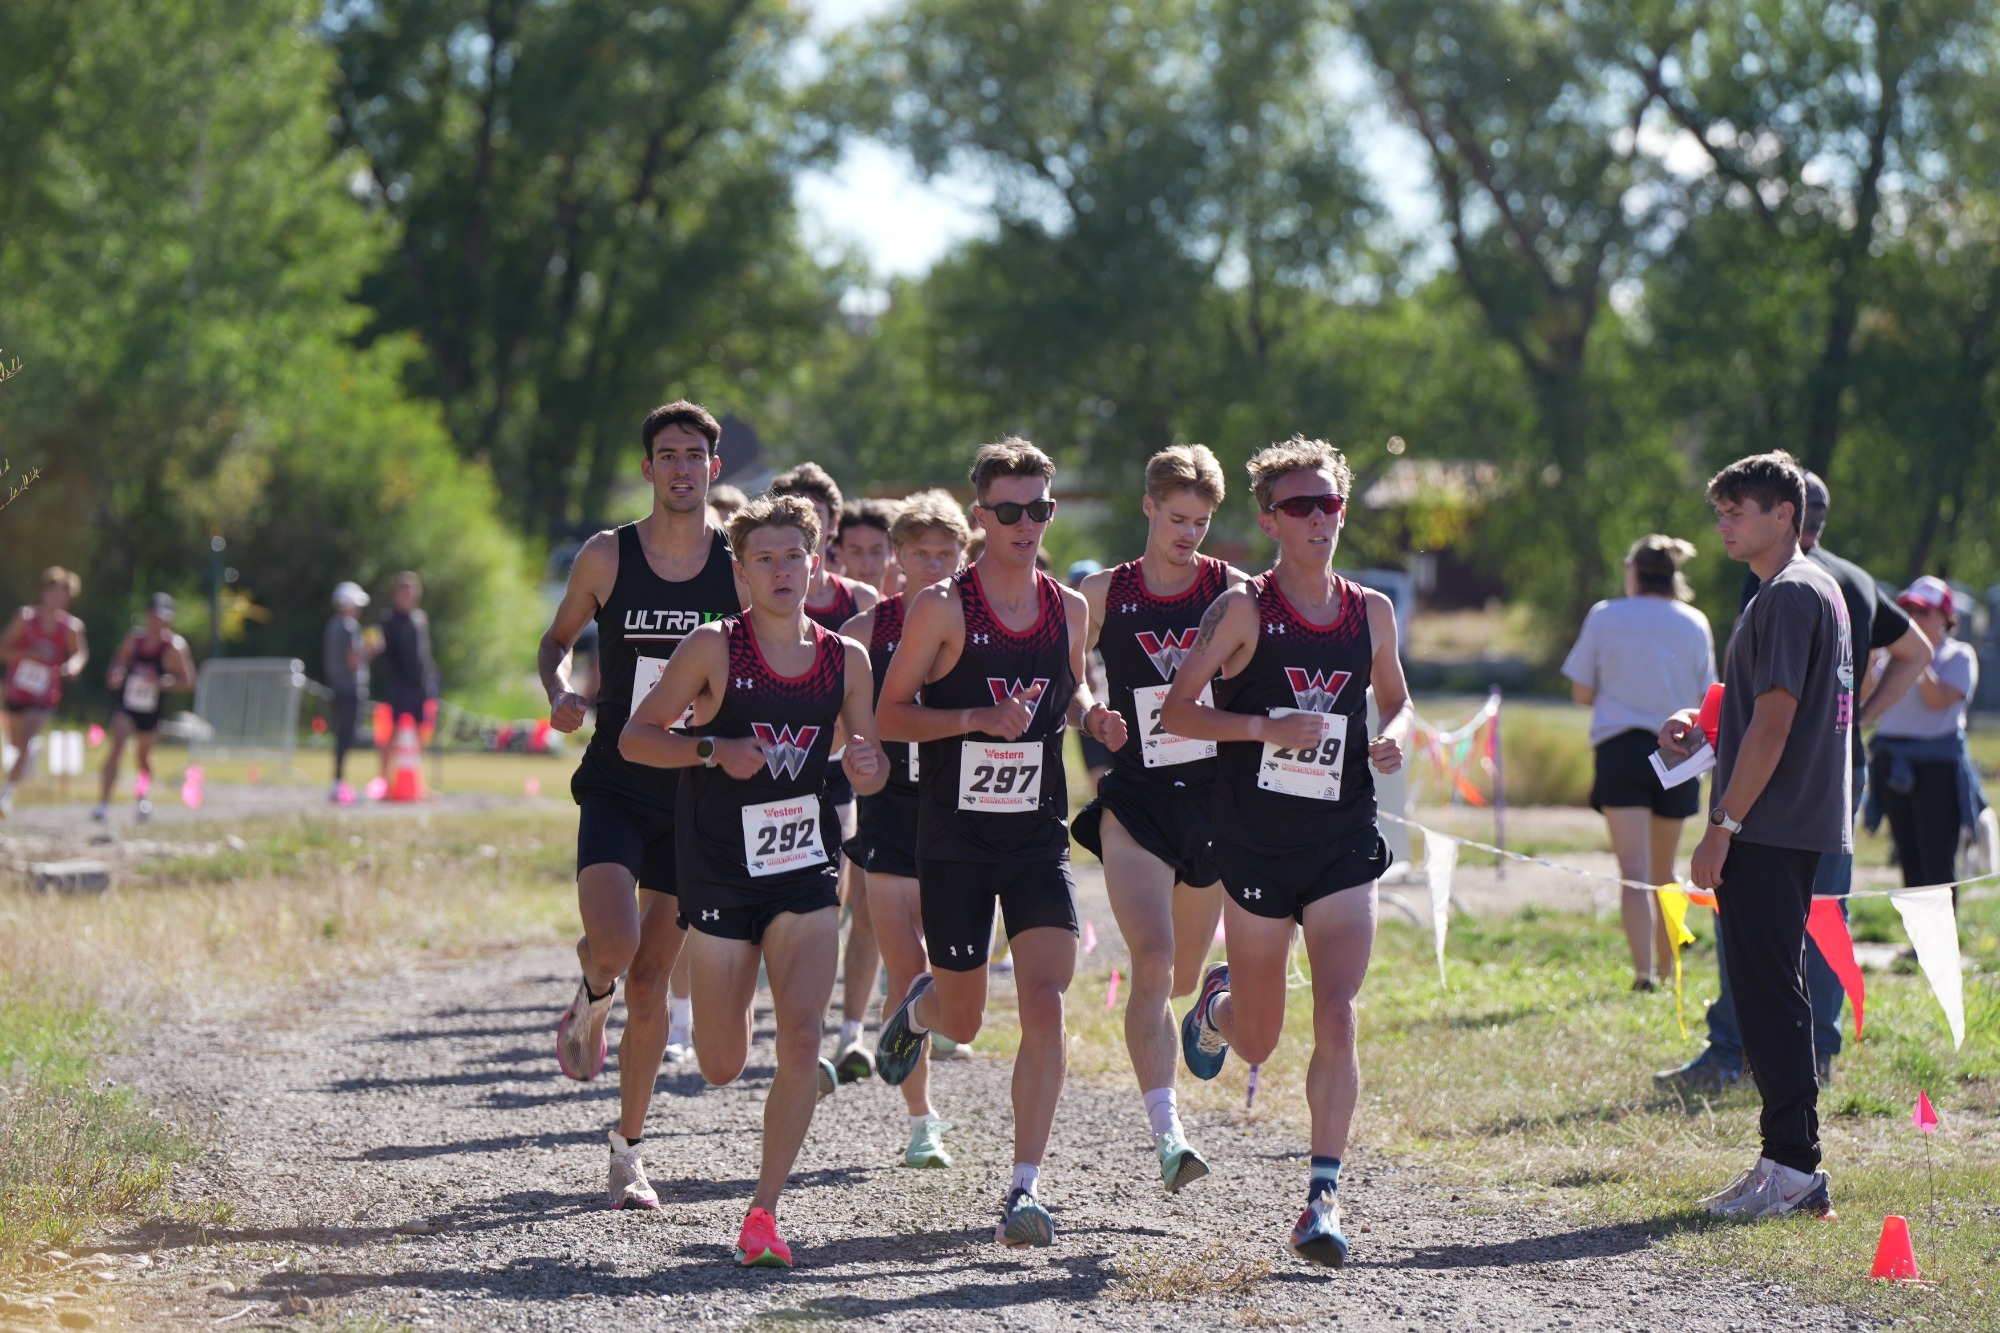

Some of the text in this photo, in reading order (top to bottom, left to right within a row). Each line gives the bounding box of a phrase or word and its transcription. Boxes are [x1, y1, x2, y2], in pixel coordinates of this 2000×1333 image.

[624, 610, 700, 631] ULTRA
[1284, 667, 1352, 713] W
[751, 722, 821, 781] W
[984, 748, 1024, 760] Western
[969, 765, 1040, 794] 297
[763, 806, 803, 818] Western
[755, 818, 815, 857] 292
